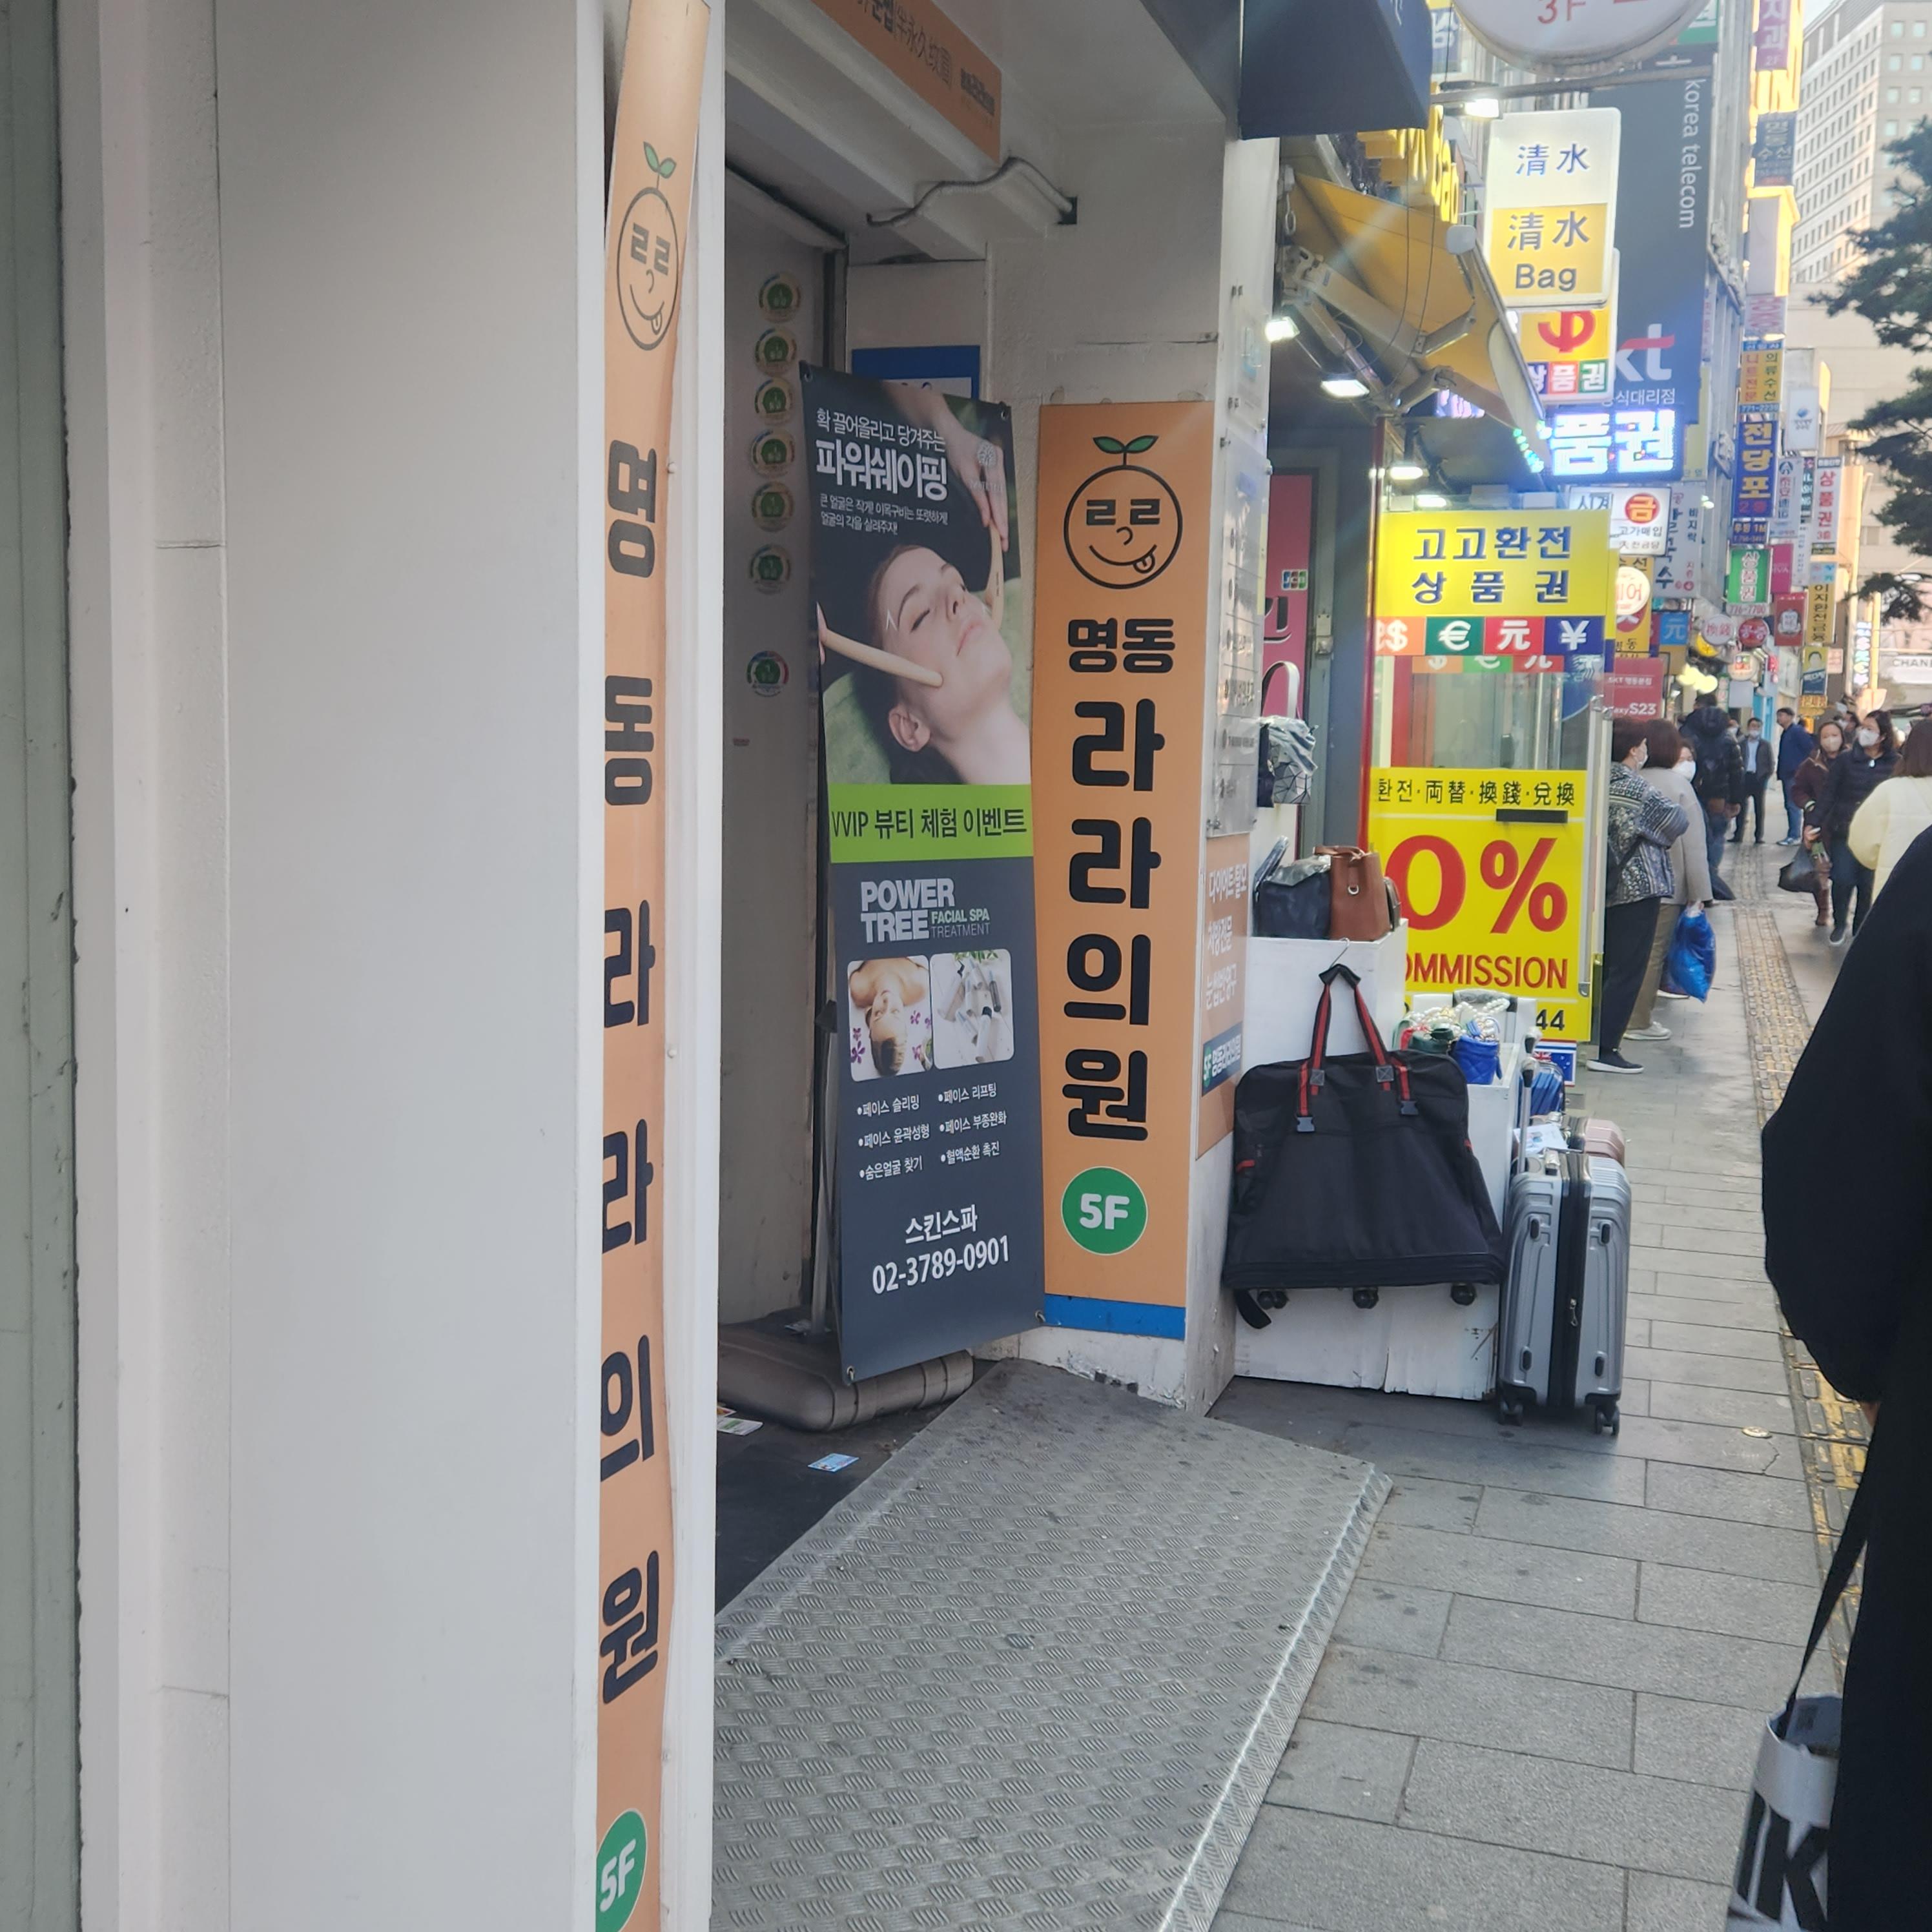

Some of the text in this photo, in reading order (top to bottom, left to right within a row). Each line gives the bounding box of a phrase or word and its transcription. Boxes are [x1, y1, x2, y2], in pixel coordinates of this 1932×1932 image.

[1516, 143, 1590, 176] 清水
[1679, 78, 1707, 228] korea telecom
[1508, 211, 1590, 251] 清水
[1516, 263, 1577, 291] Bag
[817, 408, 946, 453] 확 끌어올리고 당겨주는
[816, 439, 948, 502] 파워쉐이핑
[821, 511, 844, 527] 얼굴의
[830, 495, 854, 511] 얼굴은
[876, 502, 915, 520] 이목구비는
[1630, 496, 1656, 521] 금
[1413, 526, 1572, 560] 고고환전
[1068, 617, 1176, 674] 명동
[1561, 620, 1589, 651] ¥
[1629, 703, 1657, 715] S23
[832, 807, 1027, 839] VVIP 뷰티 체험 이벤트
[861, 878, 955, 912] POWER
[1385, 835, 1568, 934] 0%
[861, 909, 930, 943] TREE
[931, 908, 991, 925] FACIAL SPA
[931, 922, 991, 938] TREATMENT
[1406, 952, 1568, 989] MMISSION
[863, 1094, 920, 1117] 페이스 슬리밍
[944, 1082, 997, 1104] 페이스 리프팅
[864, 1124, 930, 1148] 페이스 윤곽성형
[945, 1111, 1007, 1134] 페이스 부종완화
[865, 1155, 923, 1181] 숨은얼굴 찾기
[946, 1140, 1000, 1165] 혈액순환 촉진
[905, 1204, 978, 1244] 스킨스파
[1079, 1193, 1131, 1230] 5F
[872, 1235, 1009, 1294] 02-3789-0901
[599, 1838, 637, 1913] 5F
